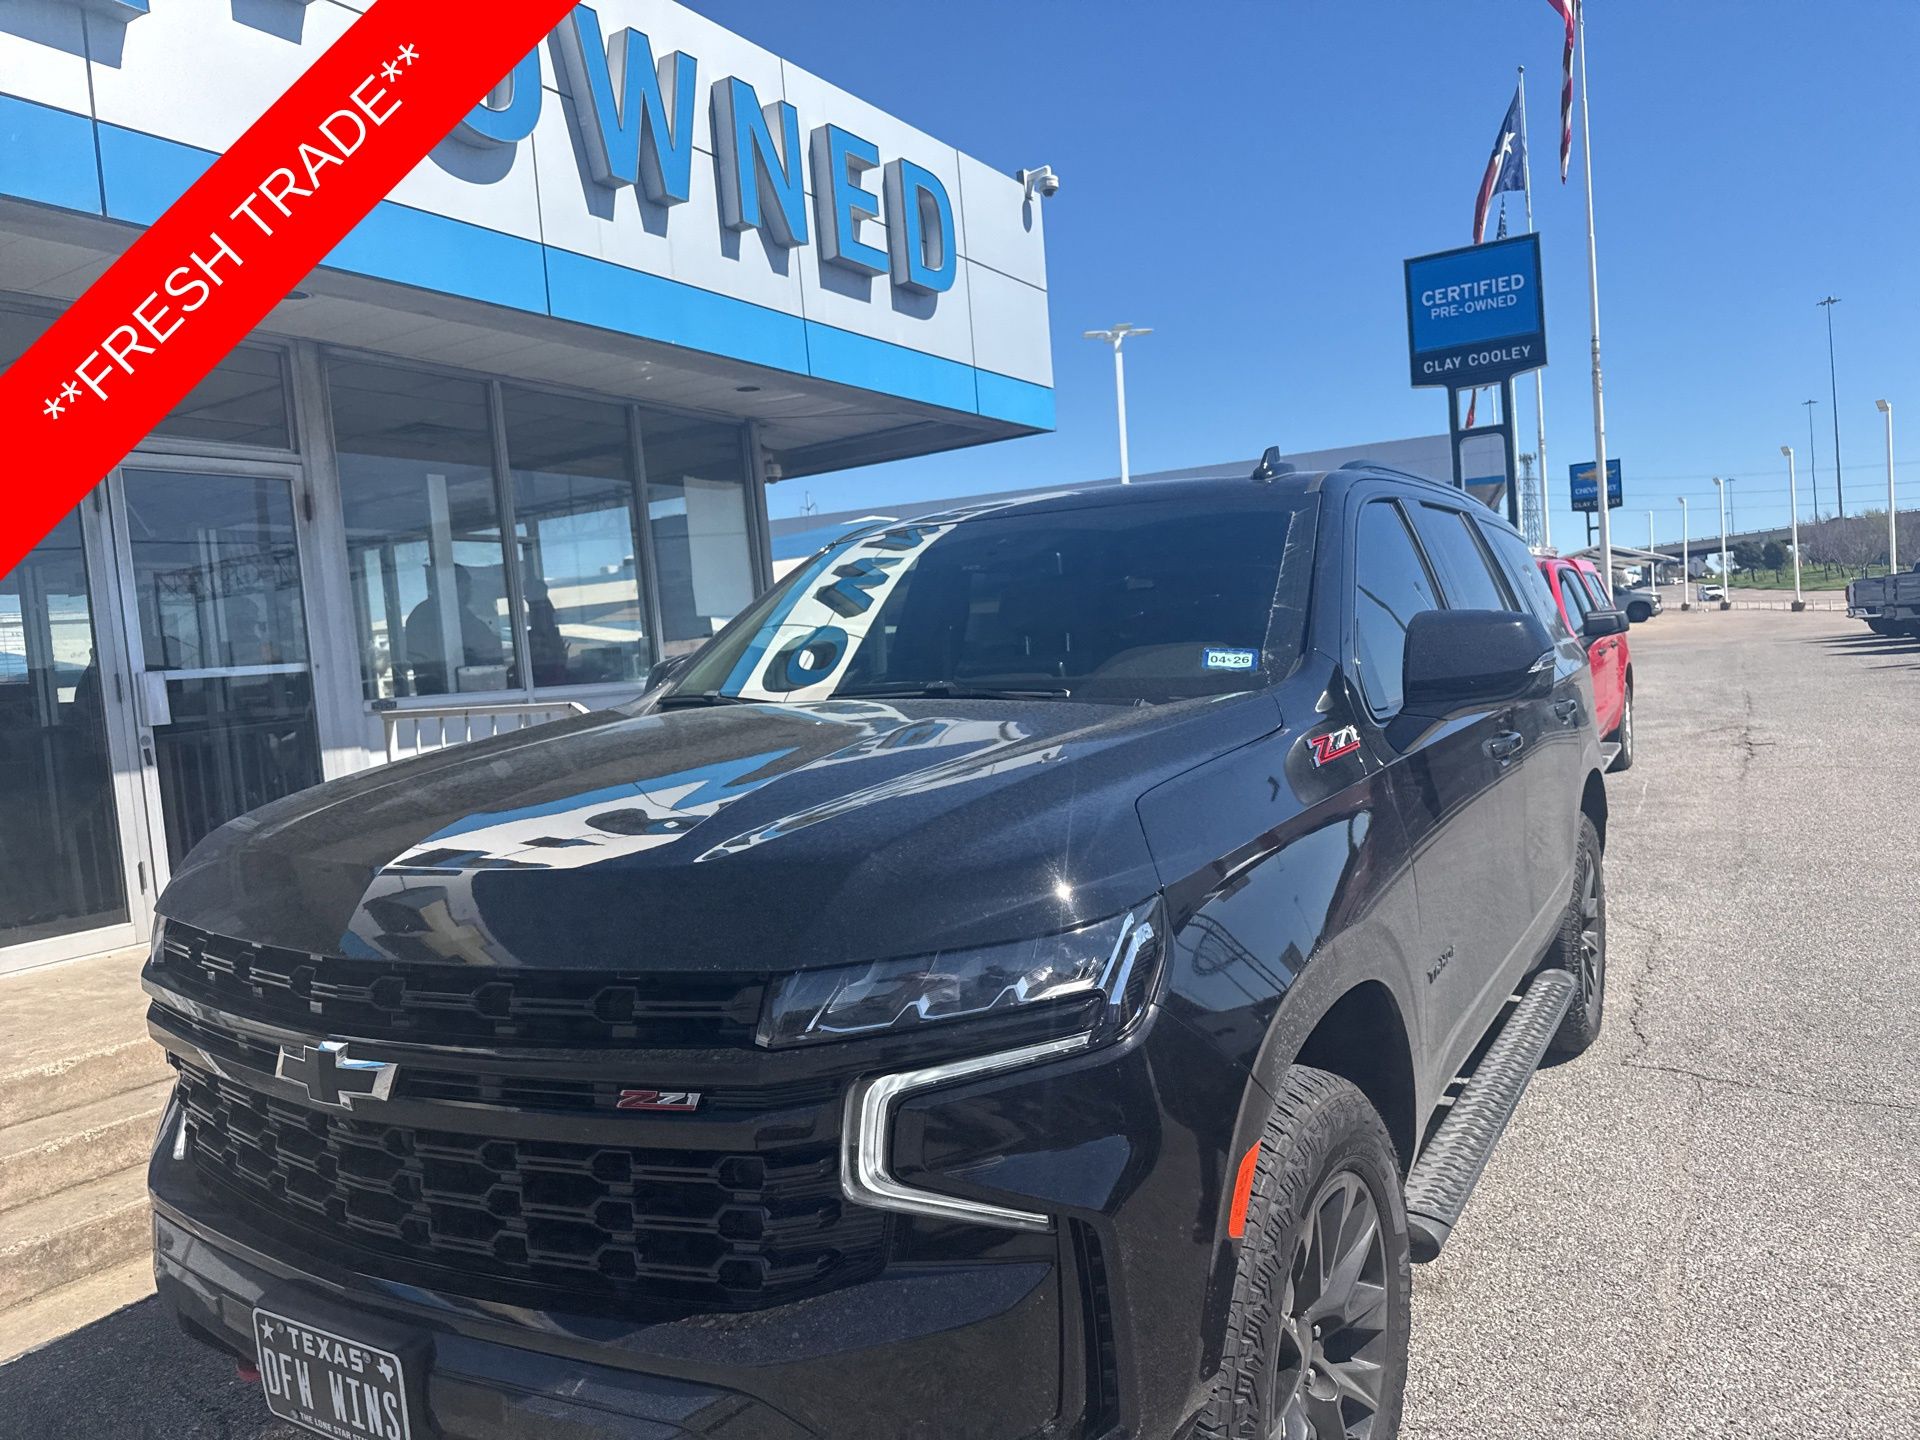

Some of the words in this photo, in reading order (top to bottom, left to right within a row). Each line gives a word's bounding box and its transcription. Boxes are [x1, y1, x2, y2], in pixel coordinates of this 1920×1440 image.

[1421, 274, 1524, 307] CERTIFIED
[1430, 294, 1517, 320] PRE-OWNED
[1423, 356, 1462, 374] CLAY
[1468, 345, 1531, 367] COOLEY
[1575, 484, 1616, 495] CHEVET
[1592, 498, 1620, 506] CEY
[1306, 725, 1361, 768] Z71
[616, 1089, 701, 1111] Z71
[287, 1325, 364, 1373] TEXAS
[263, 1346, 314, 1410] DFW
[328, 1370, 401, 1440] WINS
[300, 1412, 314, 1424] THE
[315, 1418, 332, 1432] LONE
[333, 1425, 351, 1440] STAR
